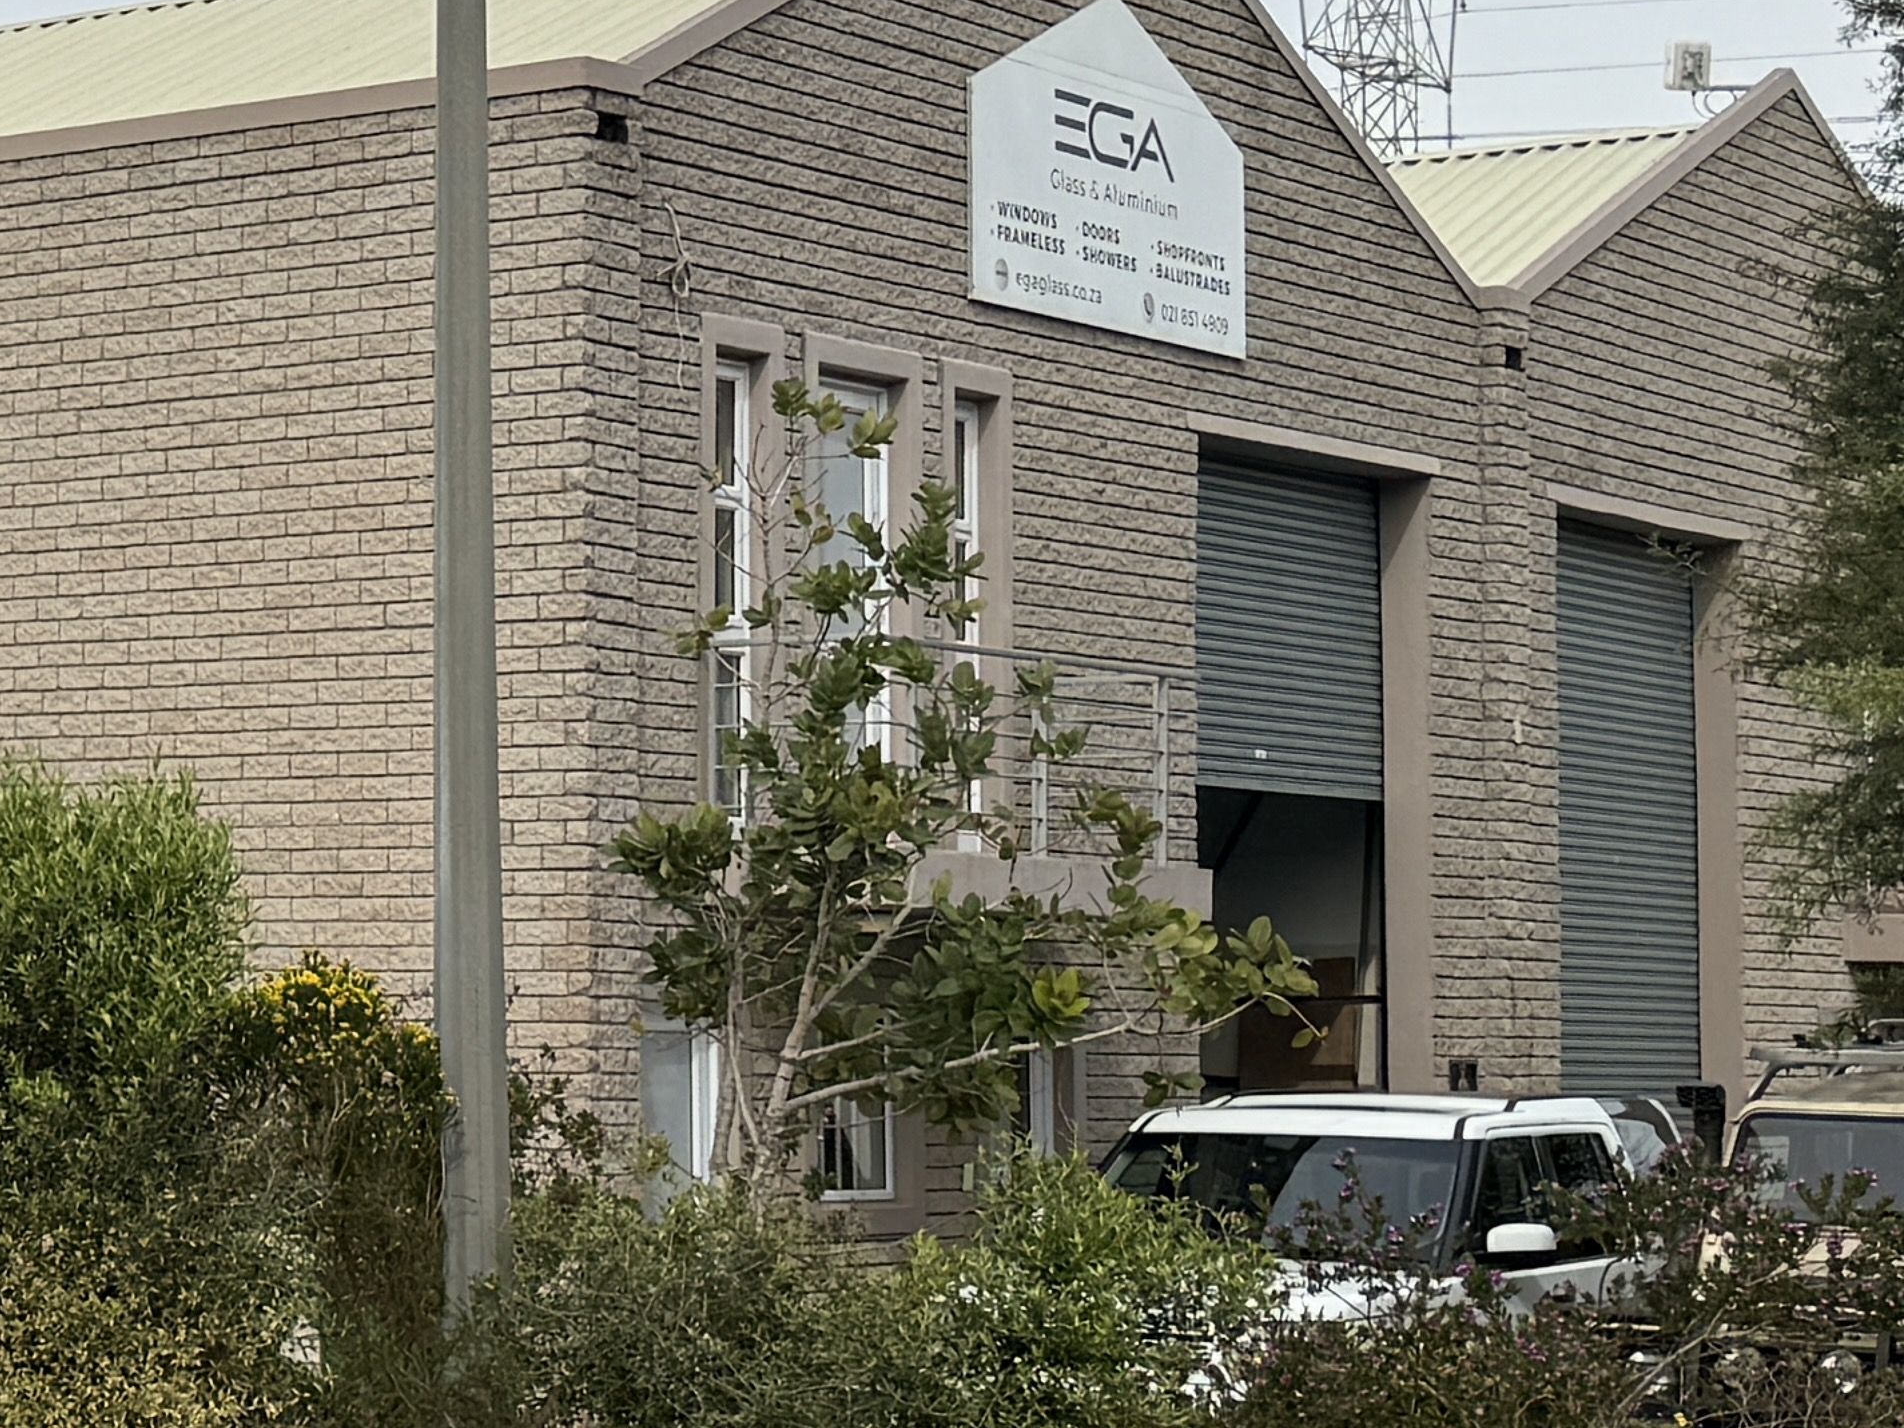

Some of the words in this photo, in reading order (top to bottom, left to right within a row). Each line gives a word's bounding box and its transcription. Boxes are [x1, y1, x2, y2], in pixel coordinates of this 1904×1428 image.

[1055, 88, 1174, 183] EGA
[1050, 168, 1086, 197] Glass
[1104, 183, 1178, 220] Aluminium
[997, 201, 1057, 229] WINDOWS
[997, 224, 1066, 255] FRAMELESS
[1082, 221, 1120, 245] DOORS
[1082, 246, 1137, 272] SHOWERS
[1157, 240, 1225, 272] SHOPFRONTS
[1016, 272, 1102, 304] egaglass.co.za
[1156, 263, 1230, 296] BALUSTRADES
[1161, 303, 1178, 324] 021
